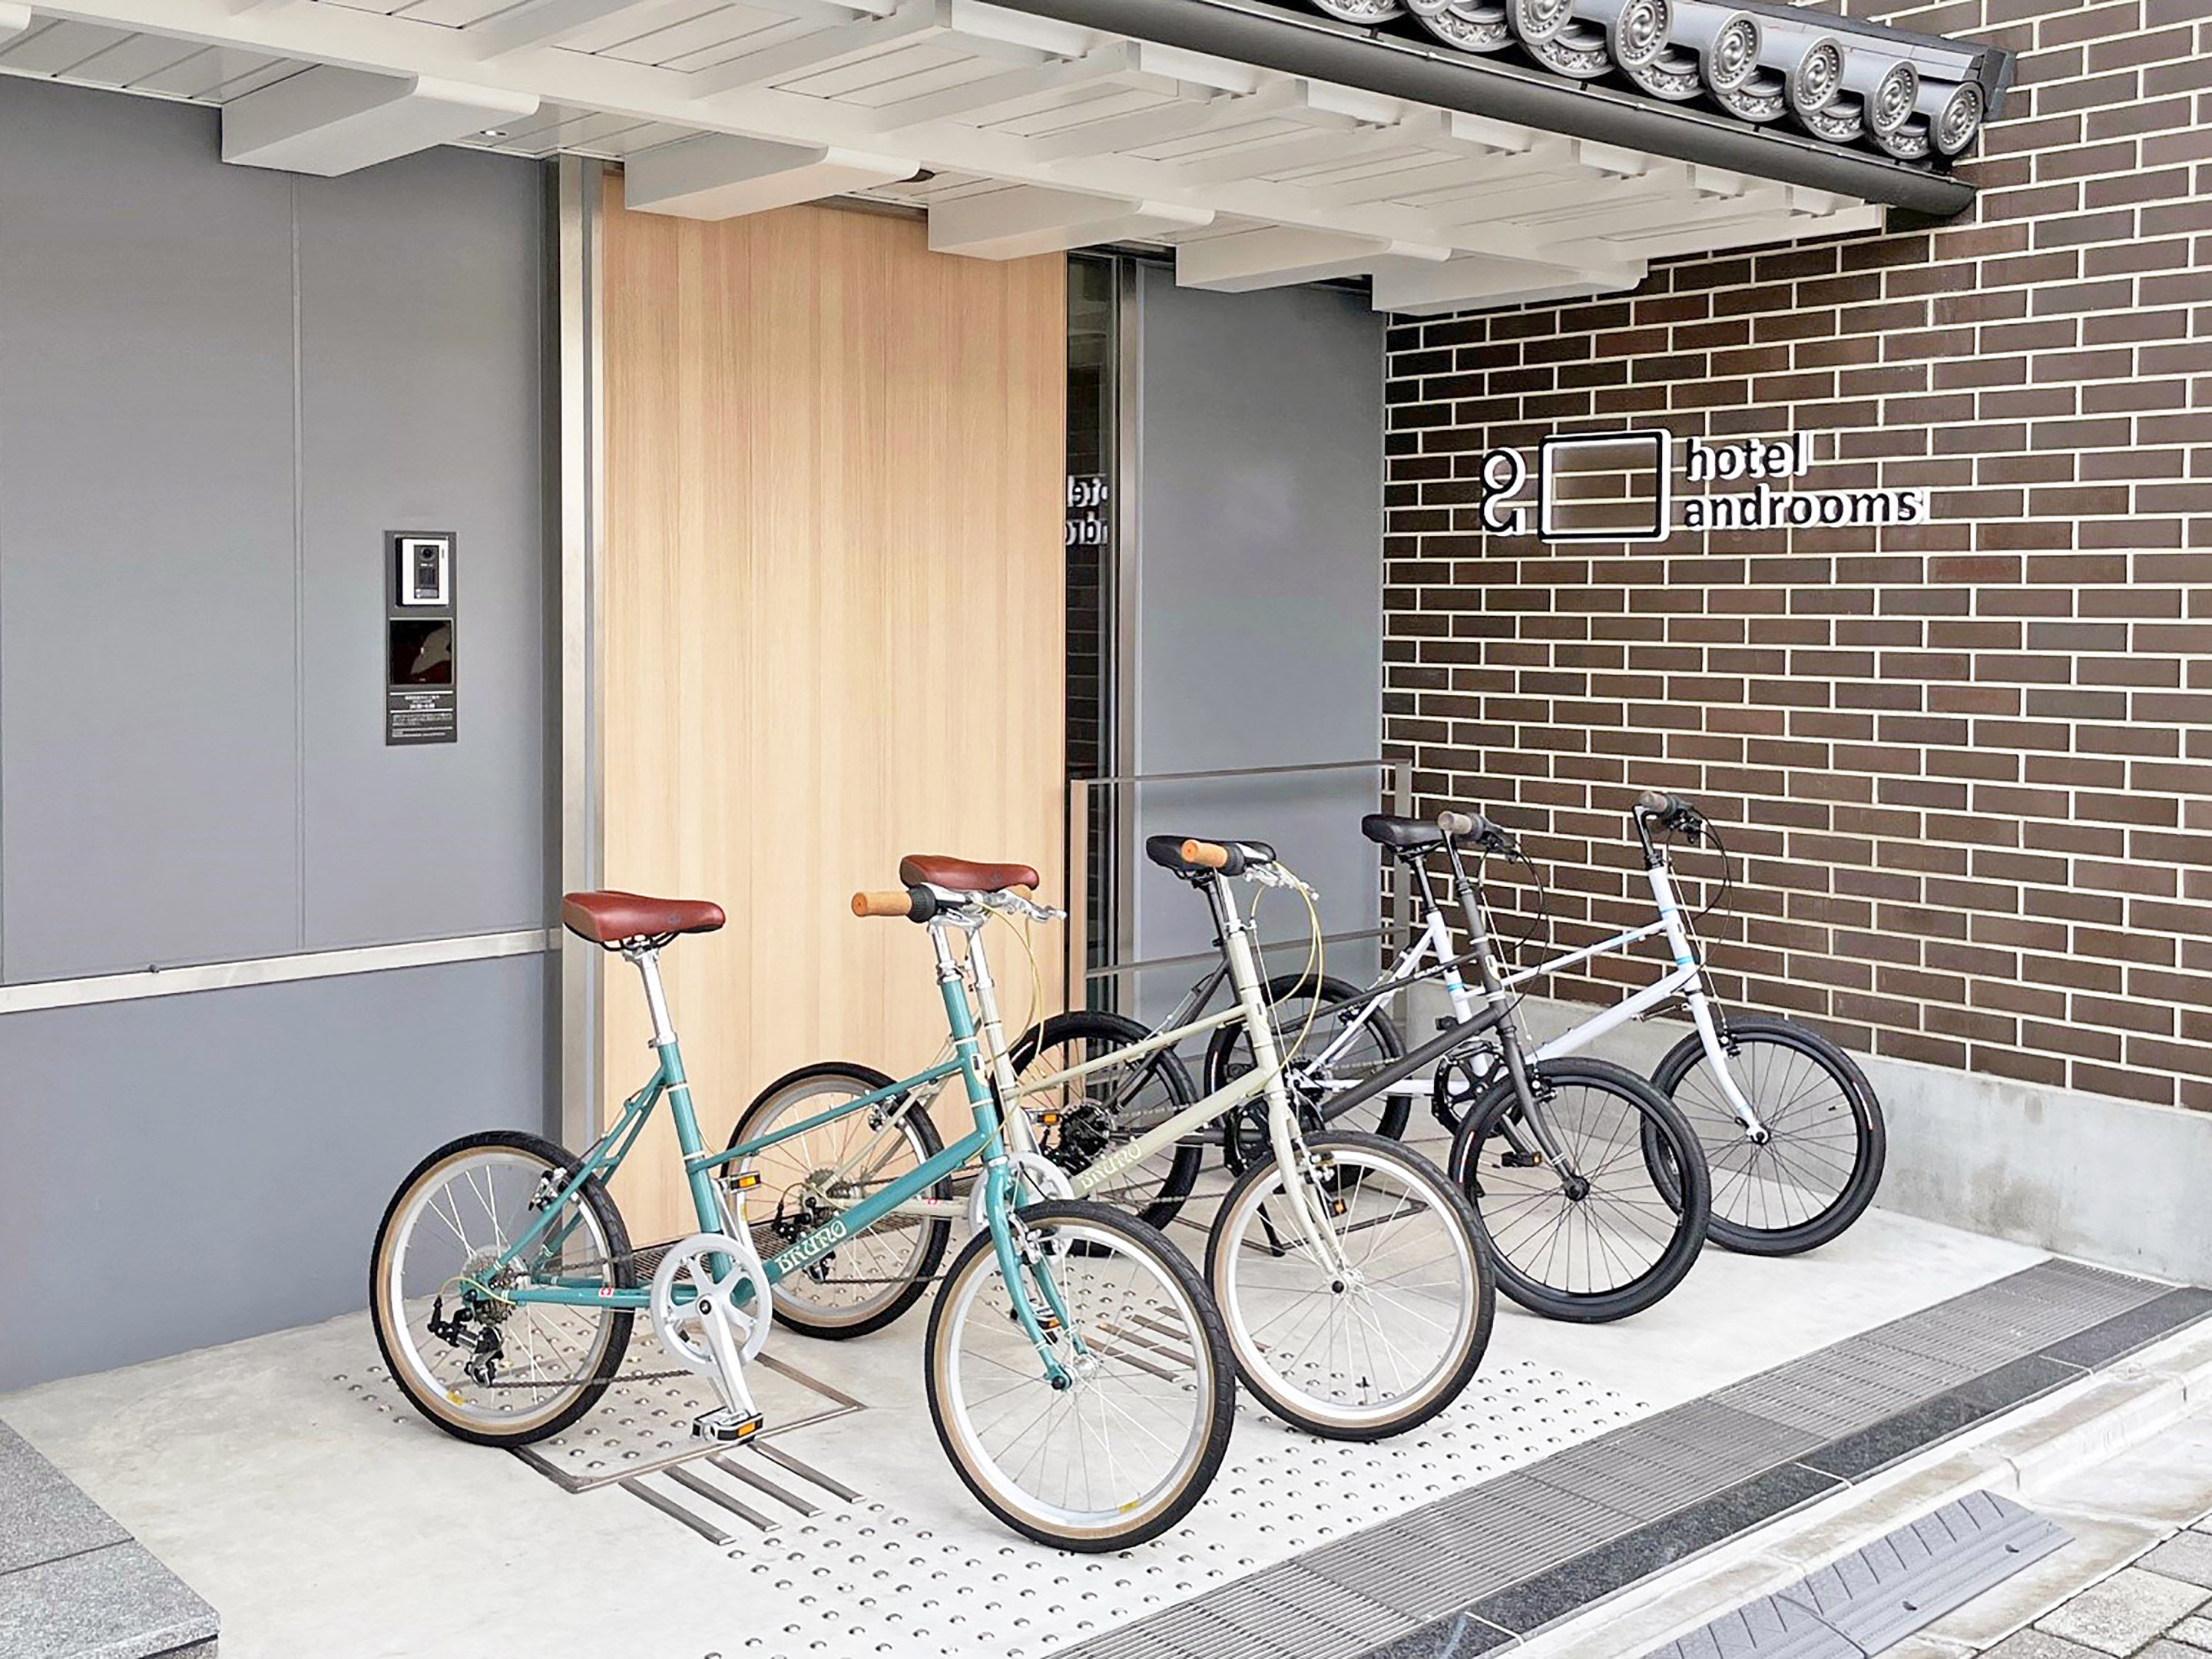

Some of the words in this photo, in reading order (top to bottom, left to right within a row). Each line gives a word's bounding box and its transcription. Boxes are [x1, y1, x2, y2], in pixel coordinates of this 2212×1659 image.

[1686, 431, 1807, 480] hotel
[1684, 484, 1929, 531] androoms
[774, 1220, 847, 1273] BRUNO
